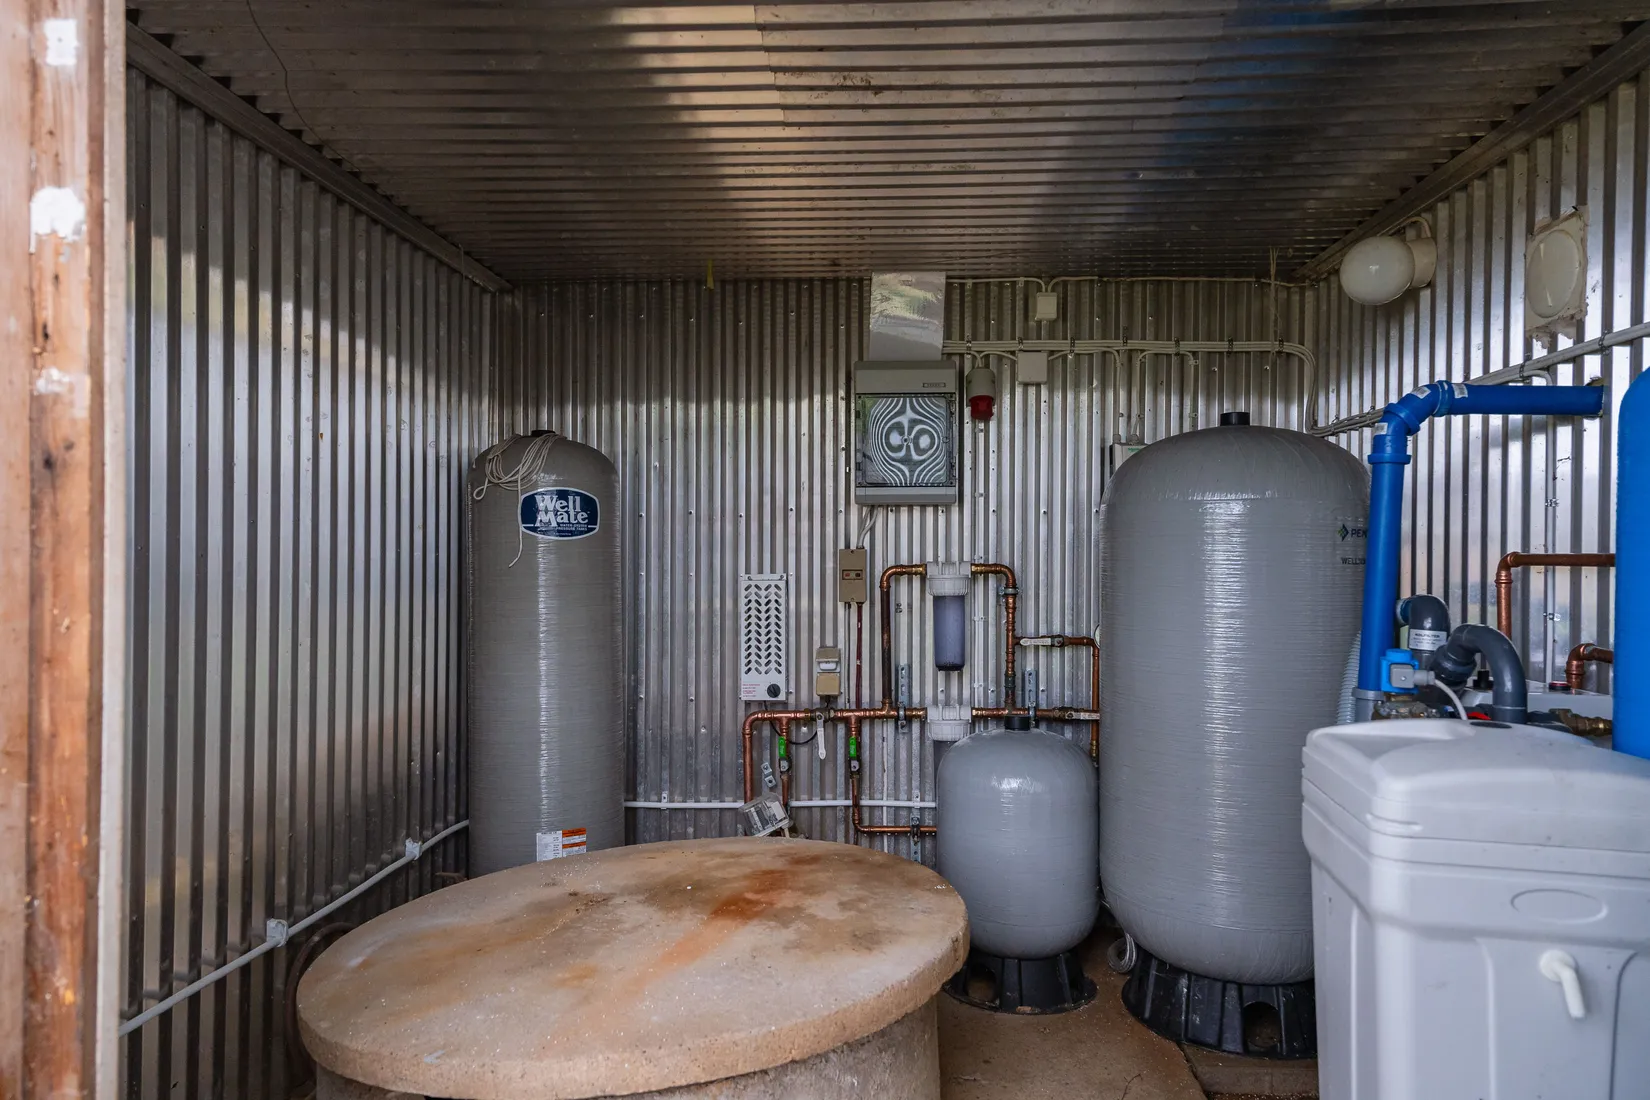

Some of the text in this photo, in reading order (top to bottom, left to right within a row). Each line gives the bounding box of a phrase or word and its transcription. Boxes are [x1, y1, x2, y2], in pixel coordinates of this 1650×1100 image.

[534, 495, 581, 512] Well
[534, 510, 589, 527] Mate
[1351, 528, 1368, 538] PEN
